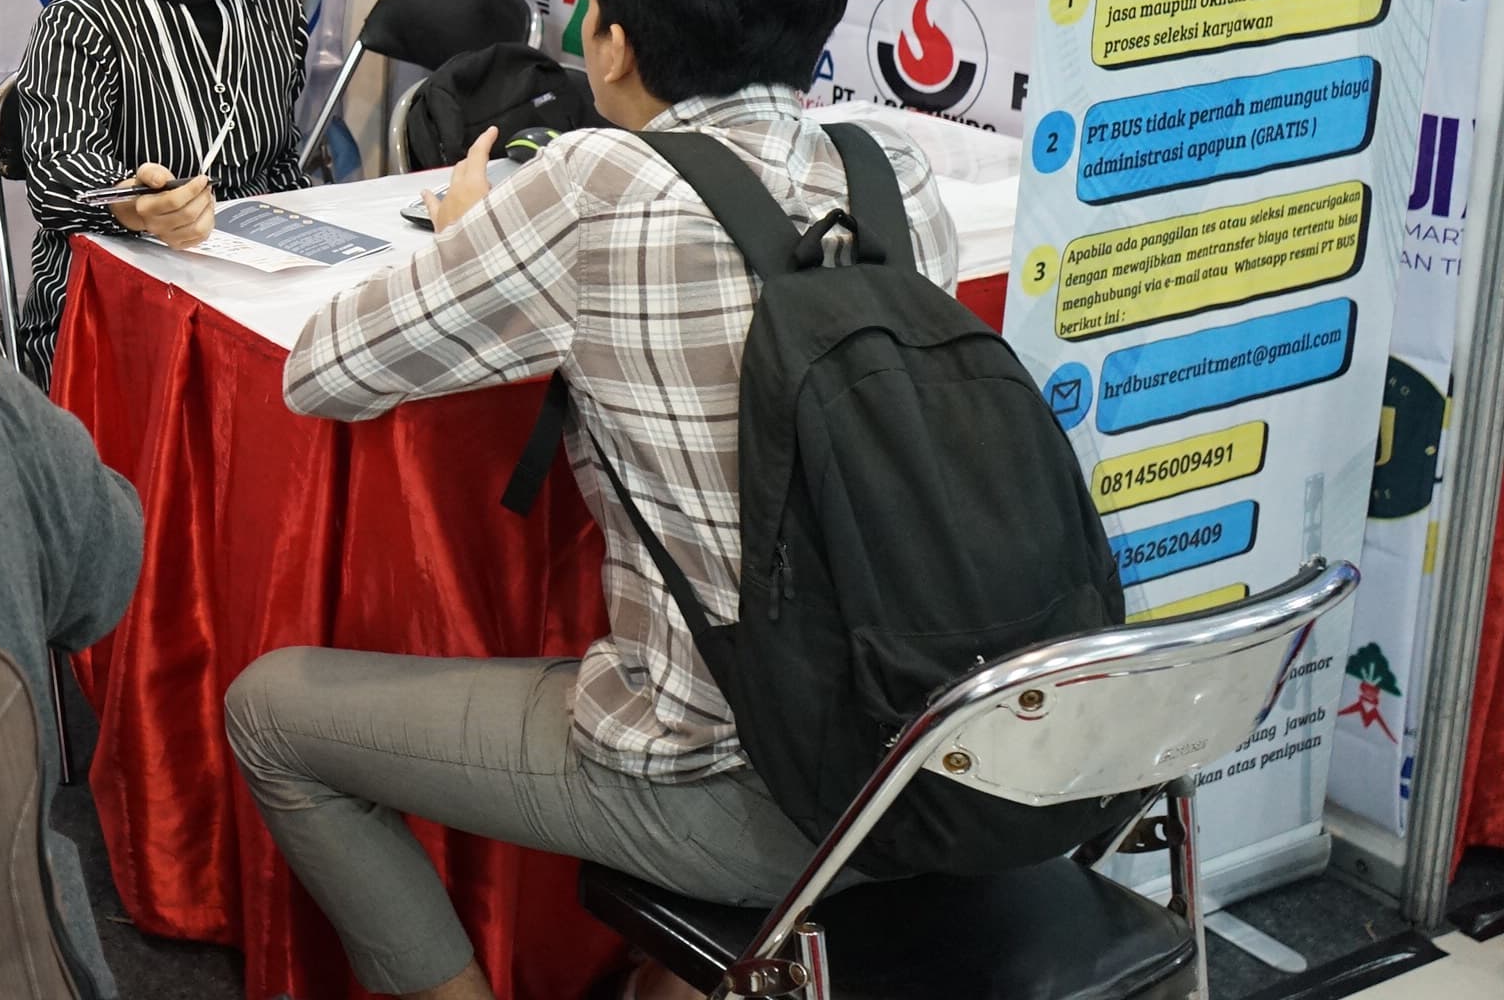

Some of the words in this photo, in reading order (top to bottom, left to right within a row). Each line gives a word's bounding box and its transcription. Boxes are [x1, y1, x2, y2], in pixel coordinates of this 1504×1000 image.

[1104, 34, 1151, 58] proses
[1188, 101, 1245, 129] pernah
[1249, 89, 1328, 116] memungut
[1046, 132, 1058, 152] 2
[1083, 142, 1184, 178] administrasi
[1188, 135, 1247, 160] apapun
[1250, 121, 1308, 151] (GRATIS
[1067, 244, 1112, 264] Apabila
[1140, 226, 1198, 251] panggilan
[1288, 191, 1361, 218] mencurigakan
[1112, 252, 1182, 281] mewajibkan
[1186, 237, 1255, 262] mentransfer
[1292, 219, 1334, 239] tertentu
[1034, 261, 1046, 281] 3
[1062, 285, 1142, 312] menghubungi
[1164, 270, 1200, 289] e-mail
[1235, 252, 1287, 274] Whatsapp
[1060, 312, 1102, 336] berikut
[1103, 329, 1342, 400] hrdbusrecruitment@gmail.com
[1100, 444, 1234, 496] 081456009491
[1289, 656, 1333, 680] nomor
[1284, 706, 1325, 736] jawab
[1227, 757, 1256, 777] atas
[1260, 735, 1322, 769] penipuan
